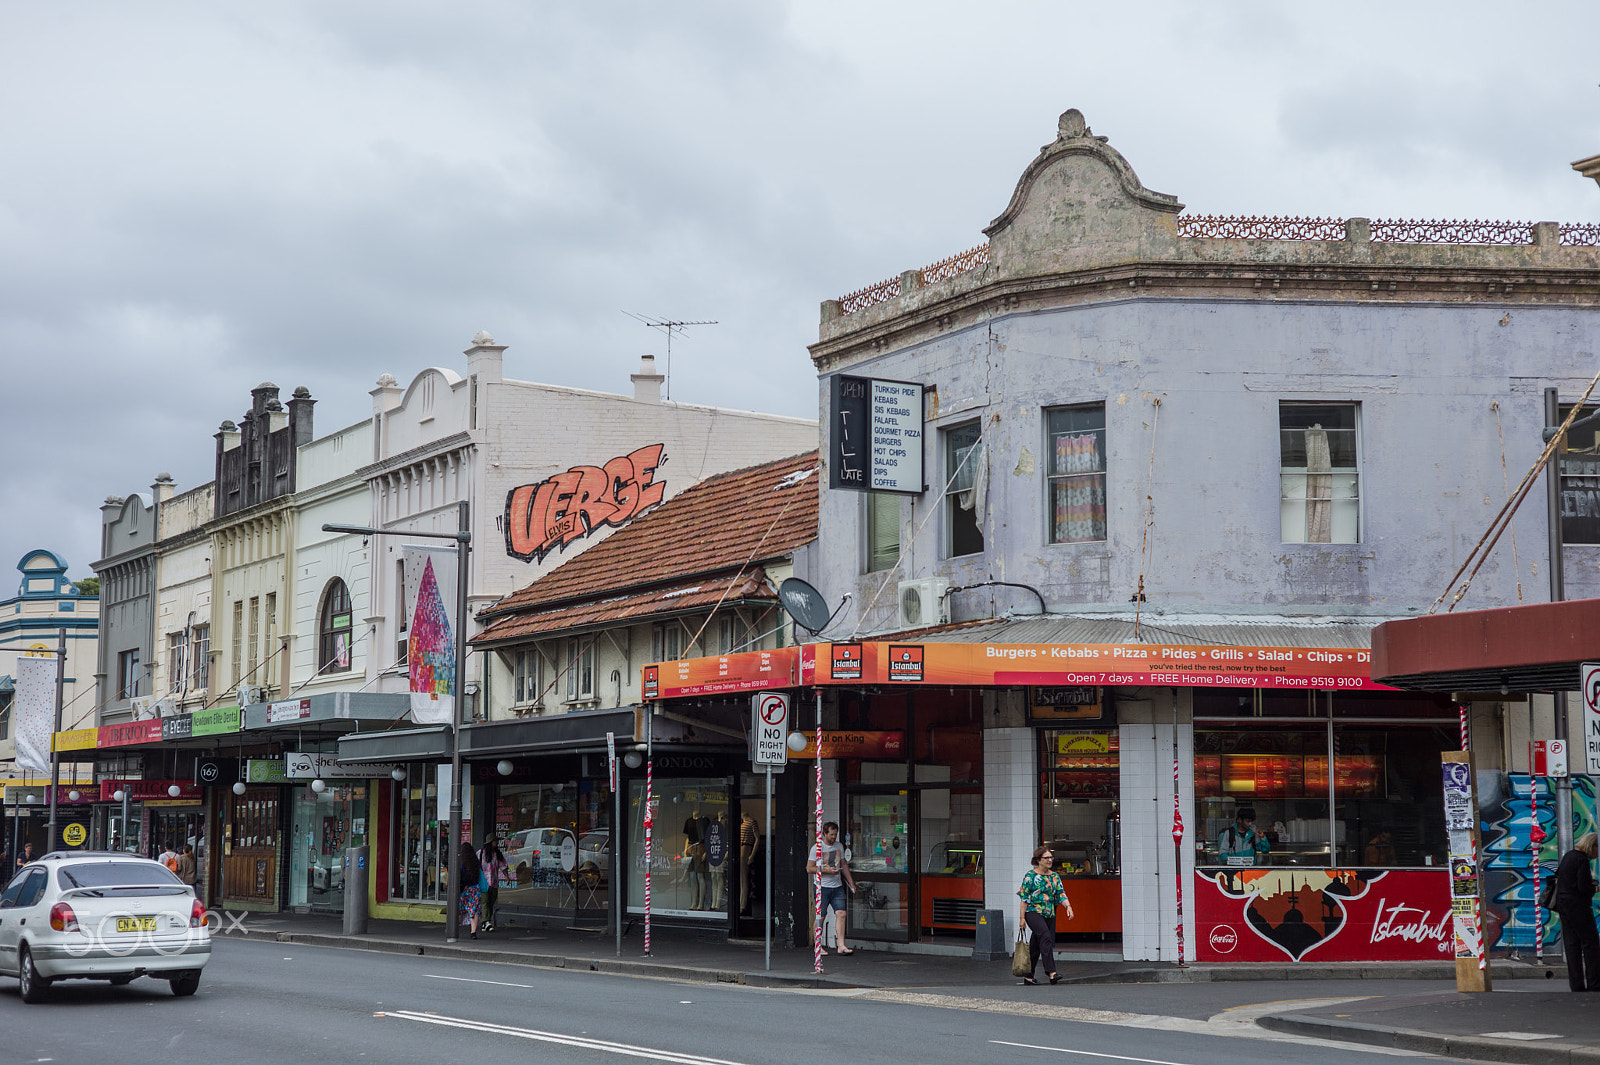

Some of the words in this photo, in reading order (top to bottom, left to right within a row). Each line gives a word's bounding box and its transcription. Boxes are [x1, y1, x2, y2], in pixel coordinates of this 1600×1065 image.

[874, 385, 900, 394] TURKISH
[902, 388, 916, 396] PIDE
[874, 396, 898, 404] KEBABS
[874, 406, 884, 414] SIS
[887, 408, 910, 416] KEBABS
[874, 417, 899, 426] FALAFEL
[874, 426, 902, 436] GOURMET
[904, 430, 920, 438] PIZZA
[874, 437, 902, 446] BURGERS
[889, 449, 906, 457] CHIPS
[874, 458, 898, 466] SALADS
[840, 468, 864, 482] LATE
[874, 468, 888, 476] DIPS
[874, 478, 897, 486] COFFEE
[504, 443, 667, 565] VERGE
[548, 520, 571, 541] ELVIS
[986, 647, 1037, 659] Burgers
[1051, 648, 1099, 658] Kebabs
[1114, 648, 1148, 658] Pizza
[1162, 648, 1196, 659] Pides
[1210, 649, 1244, 660] Grills
[1258, 650, 1293, 661] Salad
[1307, 651, 1343, 664] Chips
[1357, 652, 1370, 662] Di
[834, 659, 860, 668] Istanbul
[891, 662, 921, 670] Istanbul
[1067, 674, 1096, 683] Open
[1100, 674, 1106, 682] 7
[1109, 674, 1133, 684] days
[1151, 674, 1179, 683] FREE
[1183, 675, 1212, 684] Home
[1216, 675, 1258, 686] Delivery
[1275, 676, 1308, 686] Phone
[1311, 677, 1335, 686] 9519
[1337, 678, 1362, 687] 9100
[194, 716, 212, 727] Newtown
[214, 713, 223, 724] Elite
[224, 710, 238, 723] Dental
[110, 724, 147, 742] IBERICO
[764, 728, 780, 739] NO
[846, 734, 865, 744] King
[1062, 736, 1084, 752] TURKISH
[760, 741, 784, 750] RIGHT
[760, 752, 782, 760] TURN
[202, 768, 216, 776] 167
[480, 766, 531, 779] goan
[108, 783, 171, 793] IBRICO
[712, 824, 719, 834] 20
[710, 845, 721, 854] OFF
[118, 918, 129, 929] CN
[132, 918, 142, 928] 47
[1370, 898, 1453, 944] Istanbul
